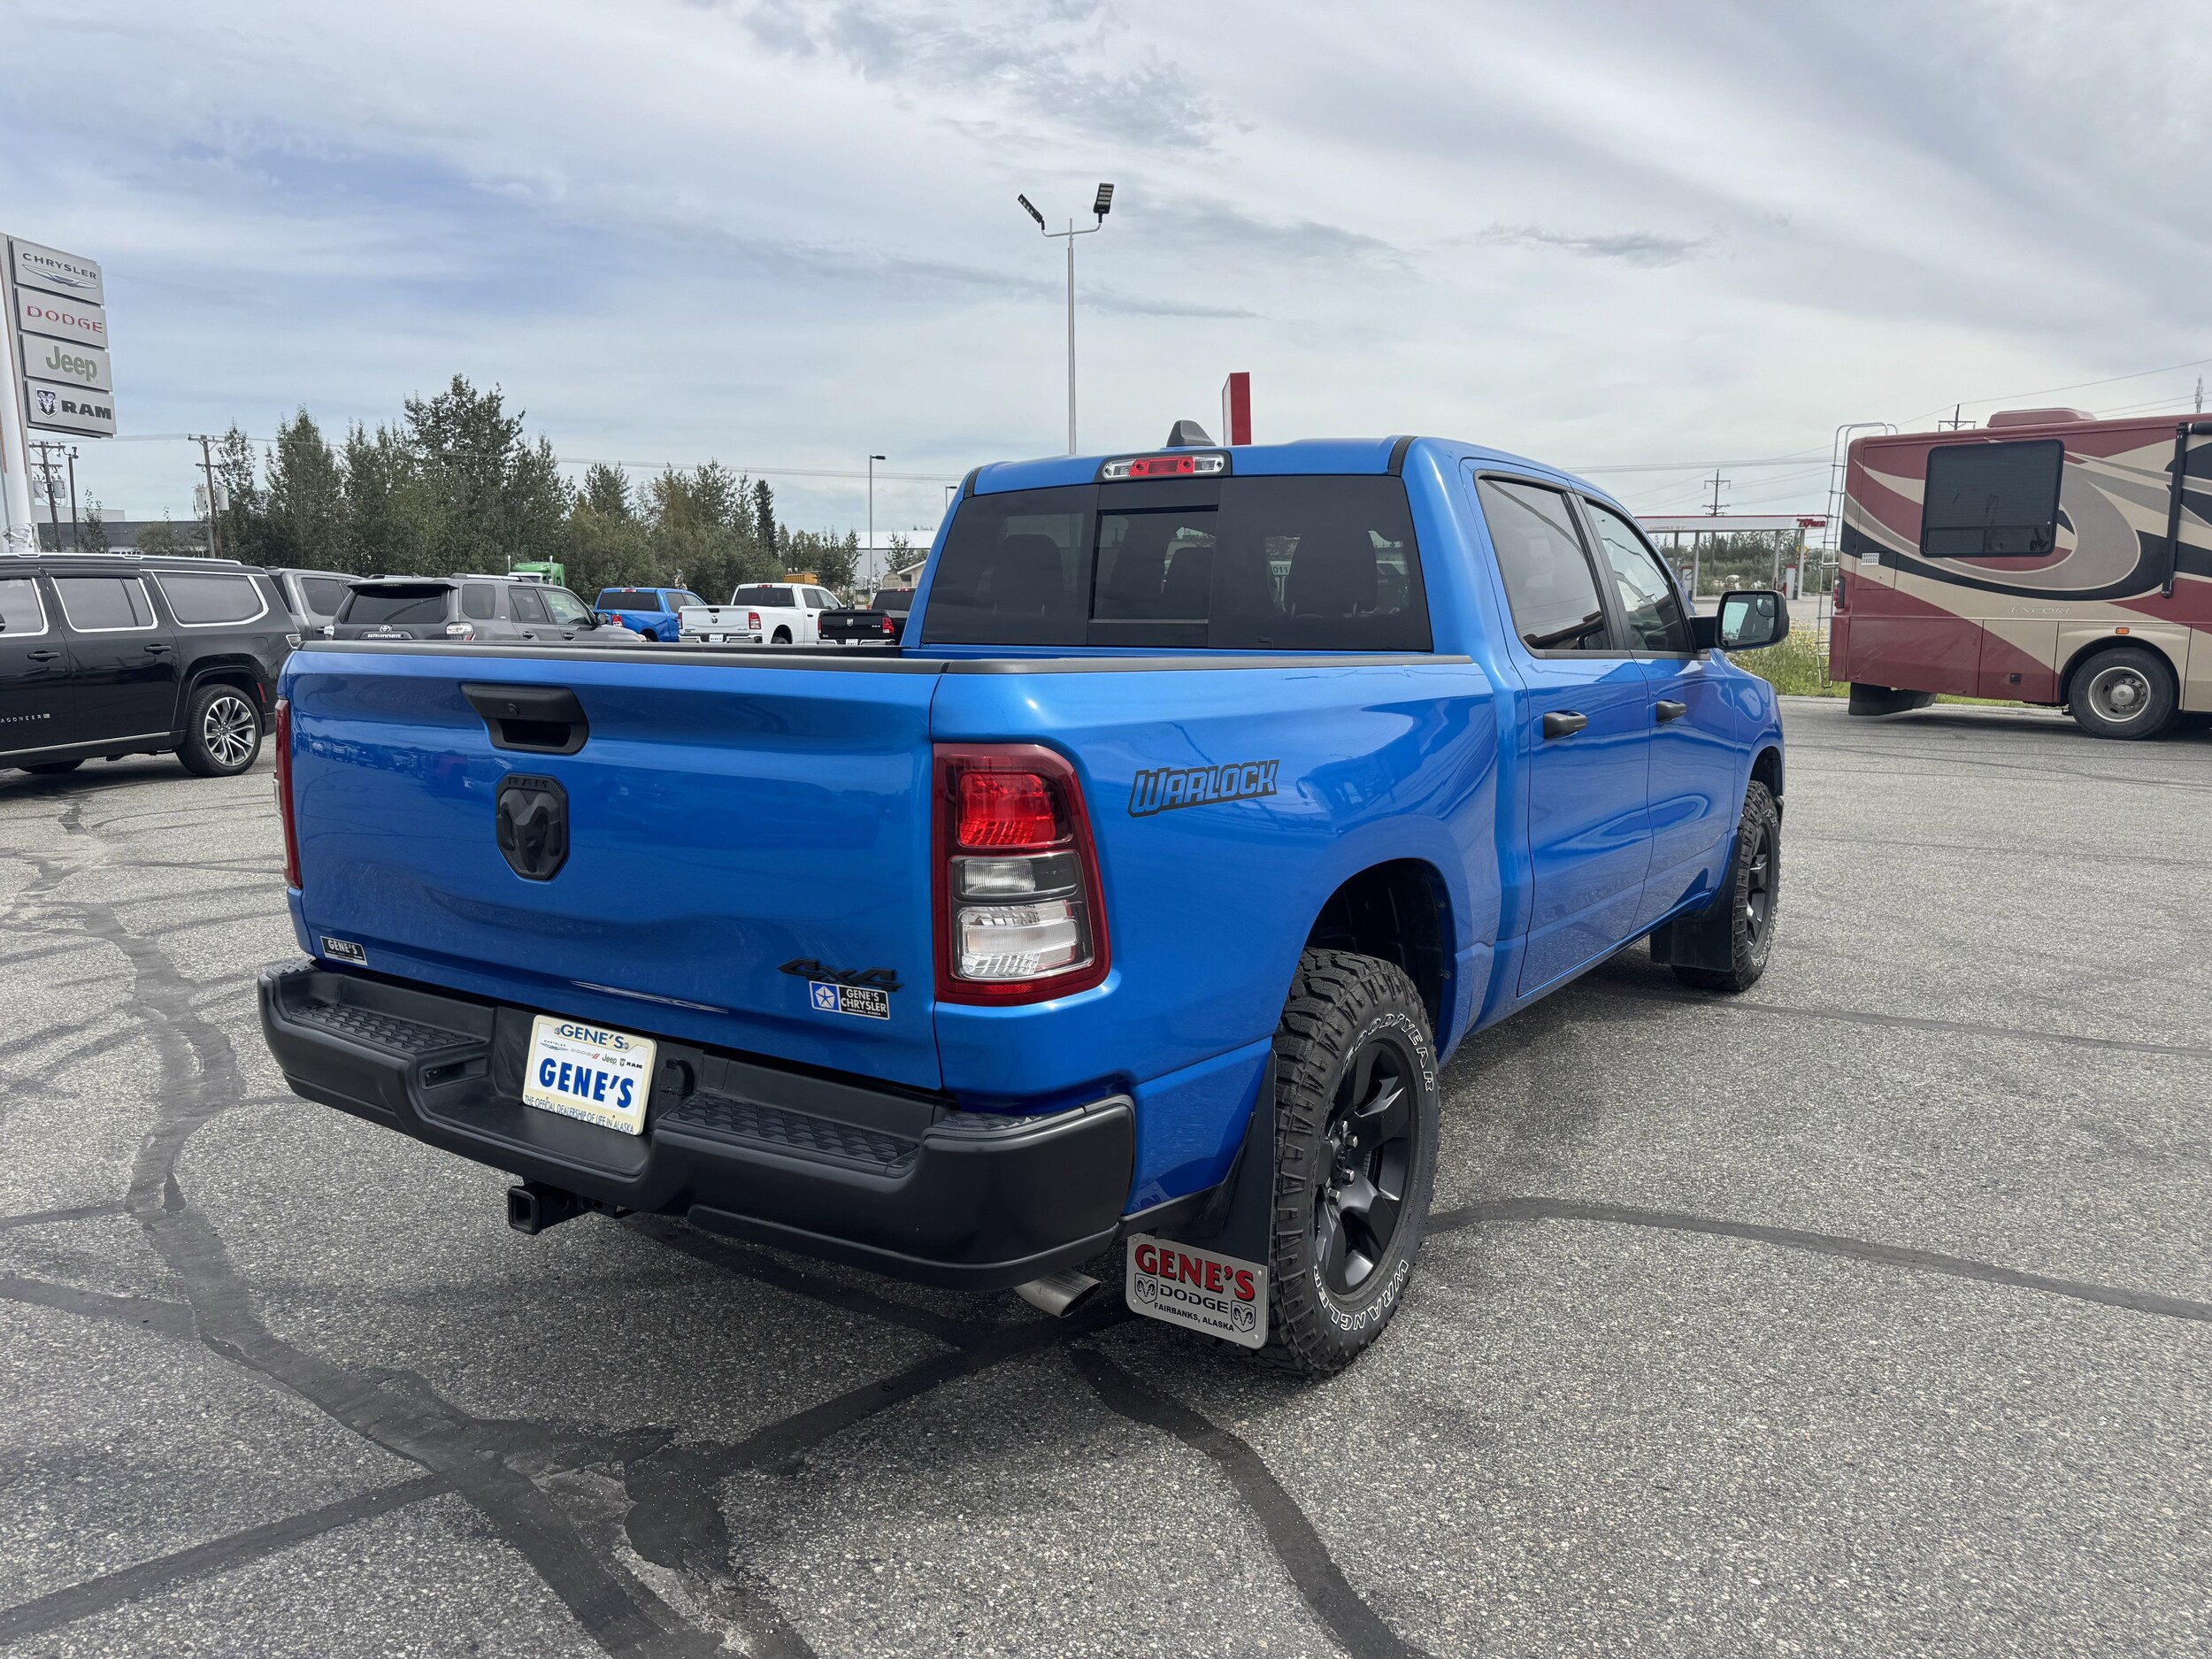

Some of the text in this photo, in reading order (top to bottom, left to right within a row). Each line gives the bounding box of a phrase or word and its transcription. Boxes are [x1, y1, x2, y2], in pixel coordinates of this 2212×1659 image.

[22, 253, 96, 280] CHRYSLER
[27, 305, 103, 334] DODGE
[45, 345, 97, 382] Jeep
[61, 400, 111, 420] RAM
[1, 714, 42, 723] AGONEER
[1127, 759, 1279, 818] WARLOCK
[327, 939, 357, 955] GENE'S
[841, 997, 887, 1013] CHRYSLER
[846, 988, 879, 1002] GENE'S
[560, 1024, 625, 1049] GENE'S
[602, 1054, 618, 1065] Jeep
[626, 1061, 643, 1070] RAM
[539, 1057, 634, 1109] GENE'S
[525, 1094, 634, 1133] THE OFFICIAL DEALERSHIP OF LIFE IN ALASKA
[1134, 1243, 1256, 1302] GENE'S
[1160, 1284, 1229, 1314] DODGE
[1313, 1259, 1409, 1331] WRANGLER
[1154, 1302, 1234, 1333] FAIRBANKS, ALASKA
